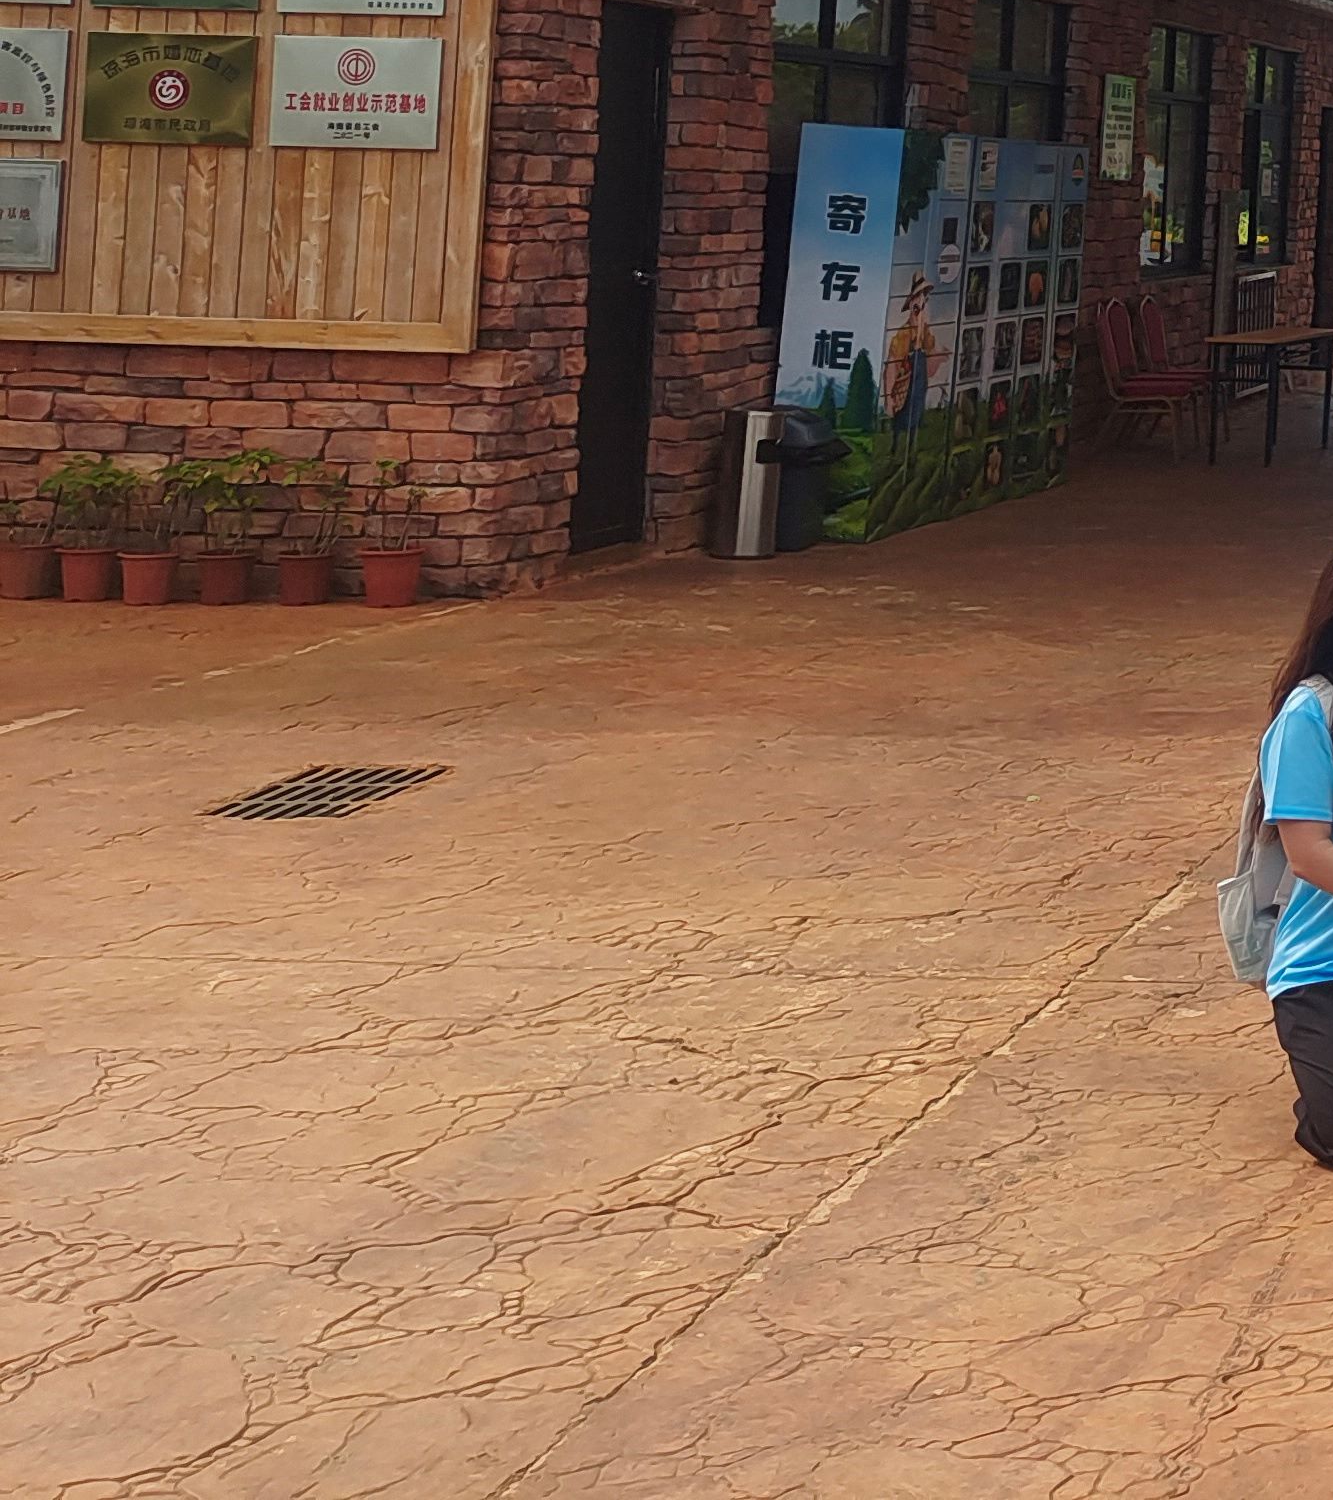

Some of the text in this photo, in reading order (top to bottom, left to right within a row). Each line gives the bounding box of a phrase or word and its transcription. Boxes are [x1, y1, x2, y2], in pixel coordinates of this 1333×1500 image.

[100, 43, 241, 83] 琼海市婚恋基地
[284, 92, 427, 114] 工会就业创业示范基地
[123, 117, 211, 133] 琼海市民政局
[812, 194, 867, 370] 寄存柜
